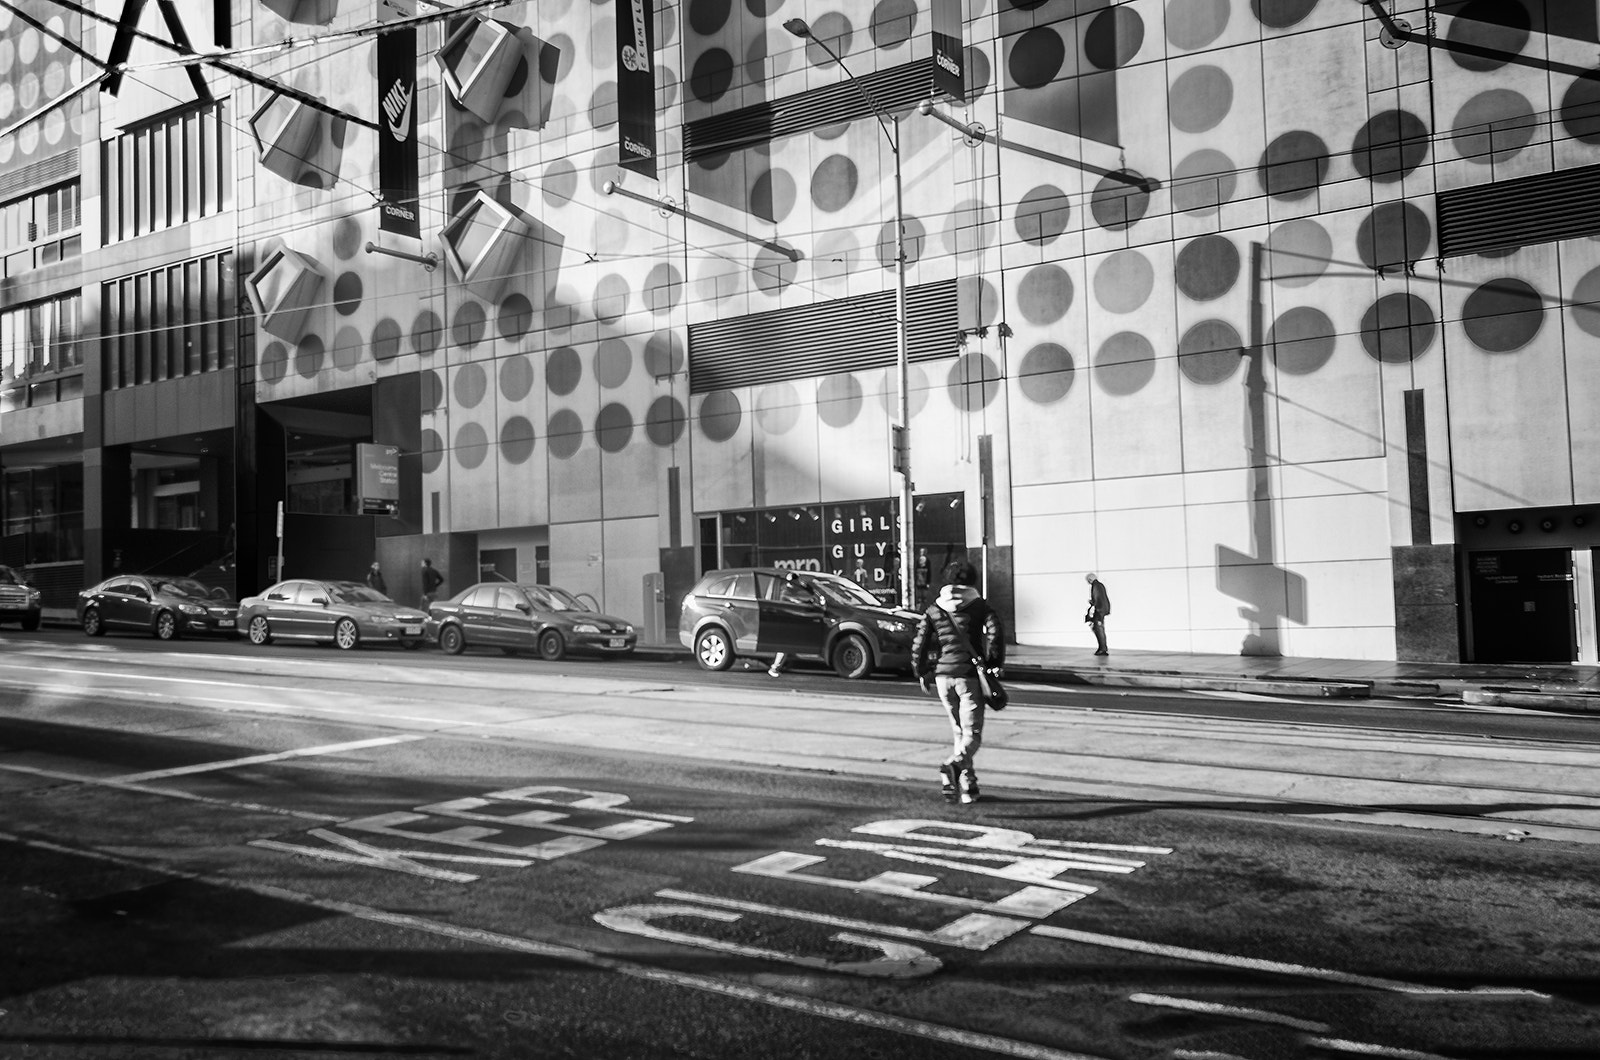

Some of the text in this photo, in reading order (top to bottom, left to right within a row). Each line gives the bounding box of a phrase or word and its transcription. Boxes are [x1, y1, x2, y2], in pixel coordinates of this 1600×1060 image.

[936, 54, 960, 77] CORNER
[382, 78, 410, 123] NIKE
[624, 140, 651, 158] CORNER
[385, 205, 415, 221] CORNER
[247, 785, 695, 883] KEEP
[592, 819, 1174, 978] CLEAR
